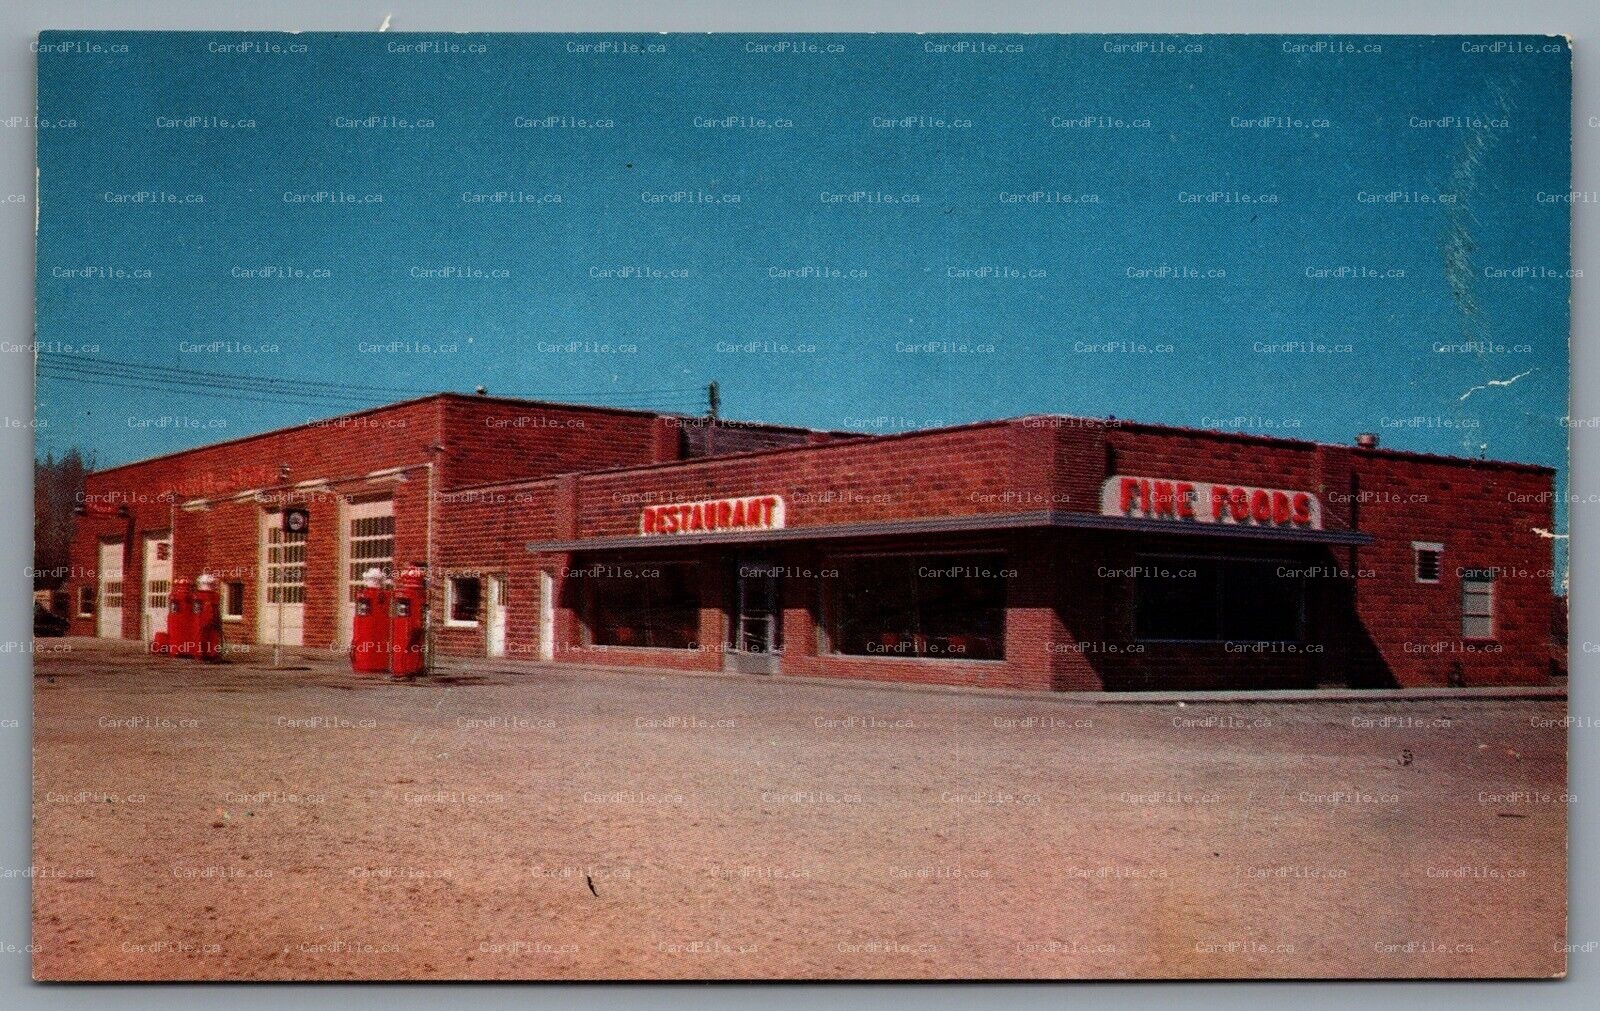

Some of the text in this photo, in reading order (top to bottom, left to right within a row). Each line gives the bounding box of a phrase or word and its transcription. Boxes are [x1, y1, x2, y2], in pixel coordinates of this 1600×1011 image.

[643, 497, 776, 534] RESTAURANT
[1120, 477, 1310, 524] FINE FOODS
